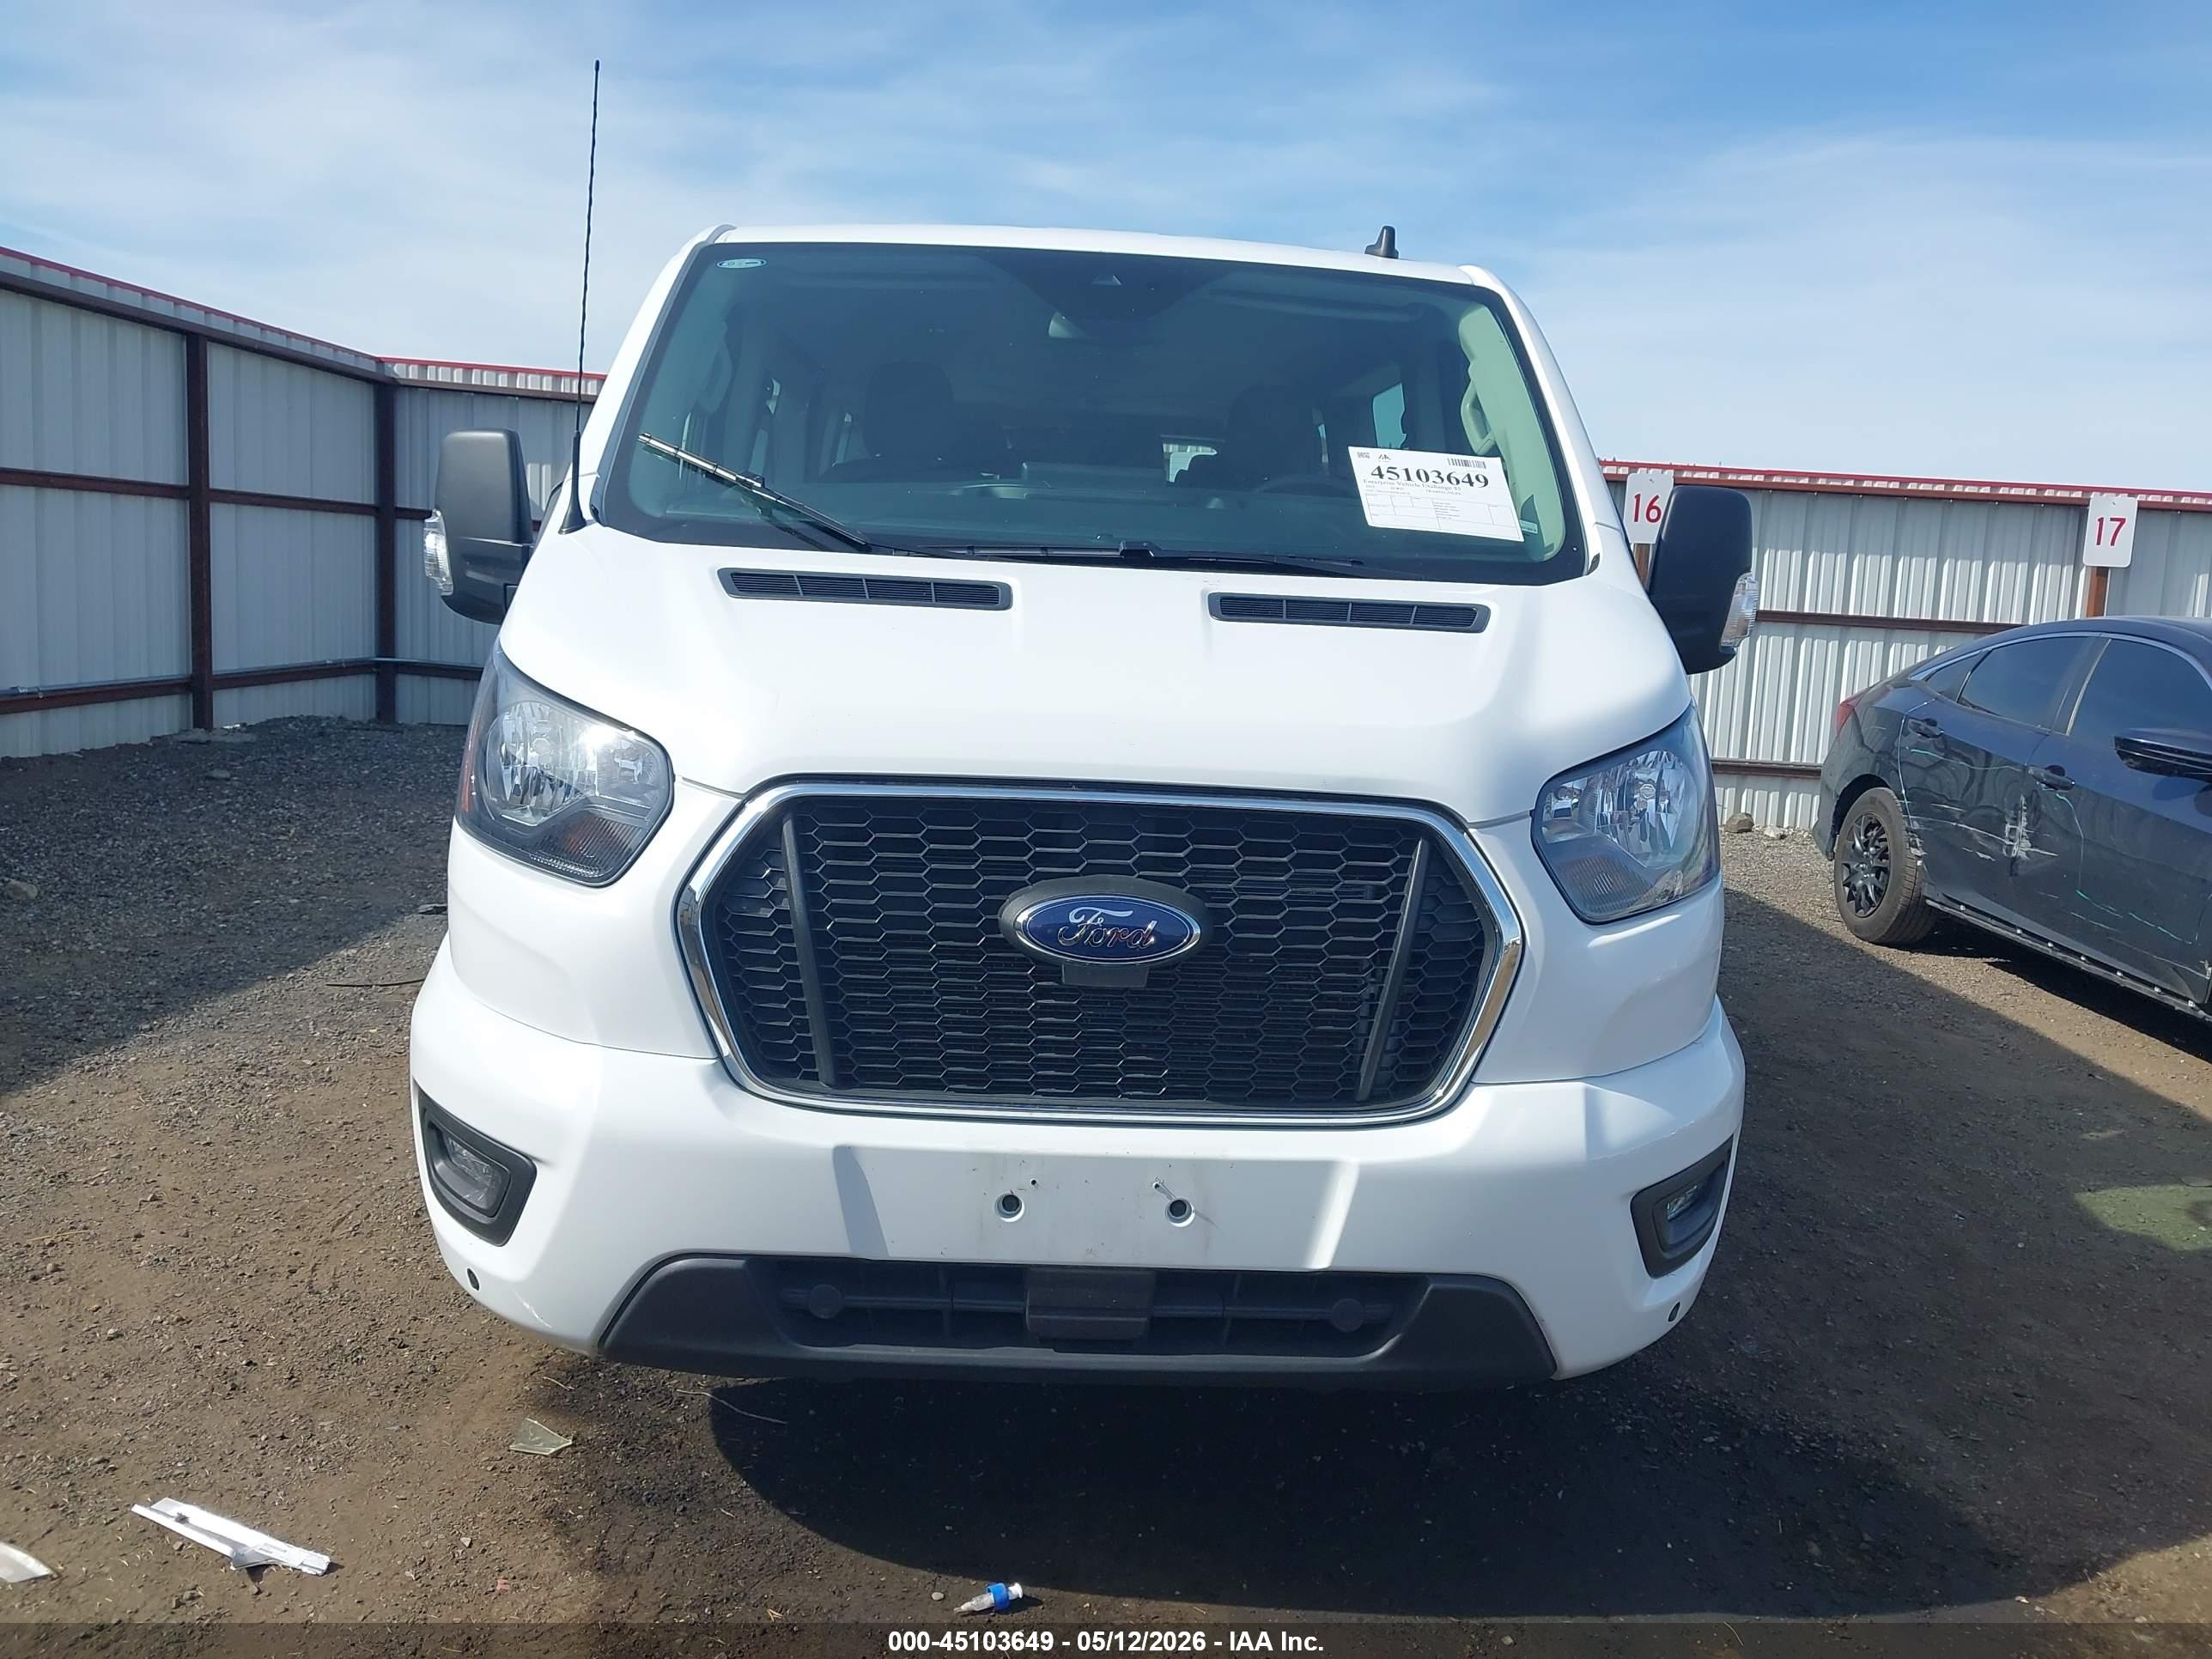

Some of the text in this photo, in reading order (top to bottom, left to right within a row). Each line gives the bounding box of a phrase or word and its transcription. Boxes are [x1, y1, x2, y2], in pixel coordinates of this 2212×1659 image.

[1370, 465, 1489, 489] 45103649
[1632, 493, 1662, 524] 16
[2095, 516, 2127, 547] 17
[1057, 906, 1158, 950] Ford
